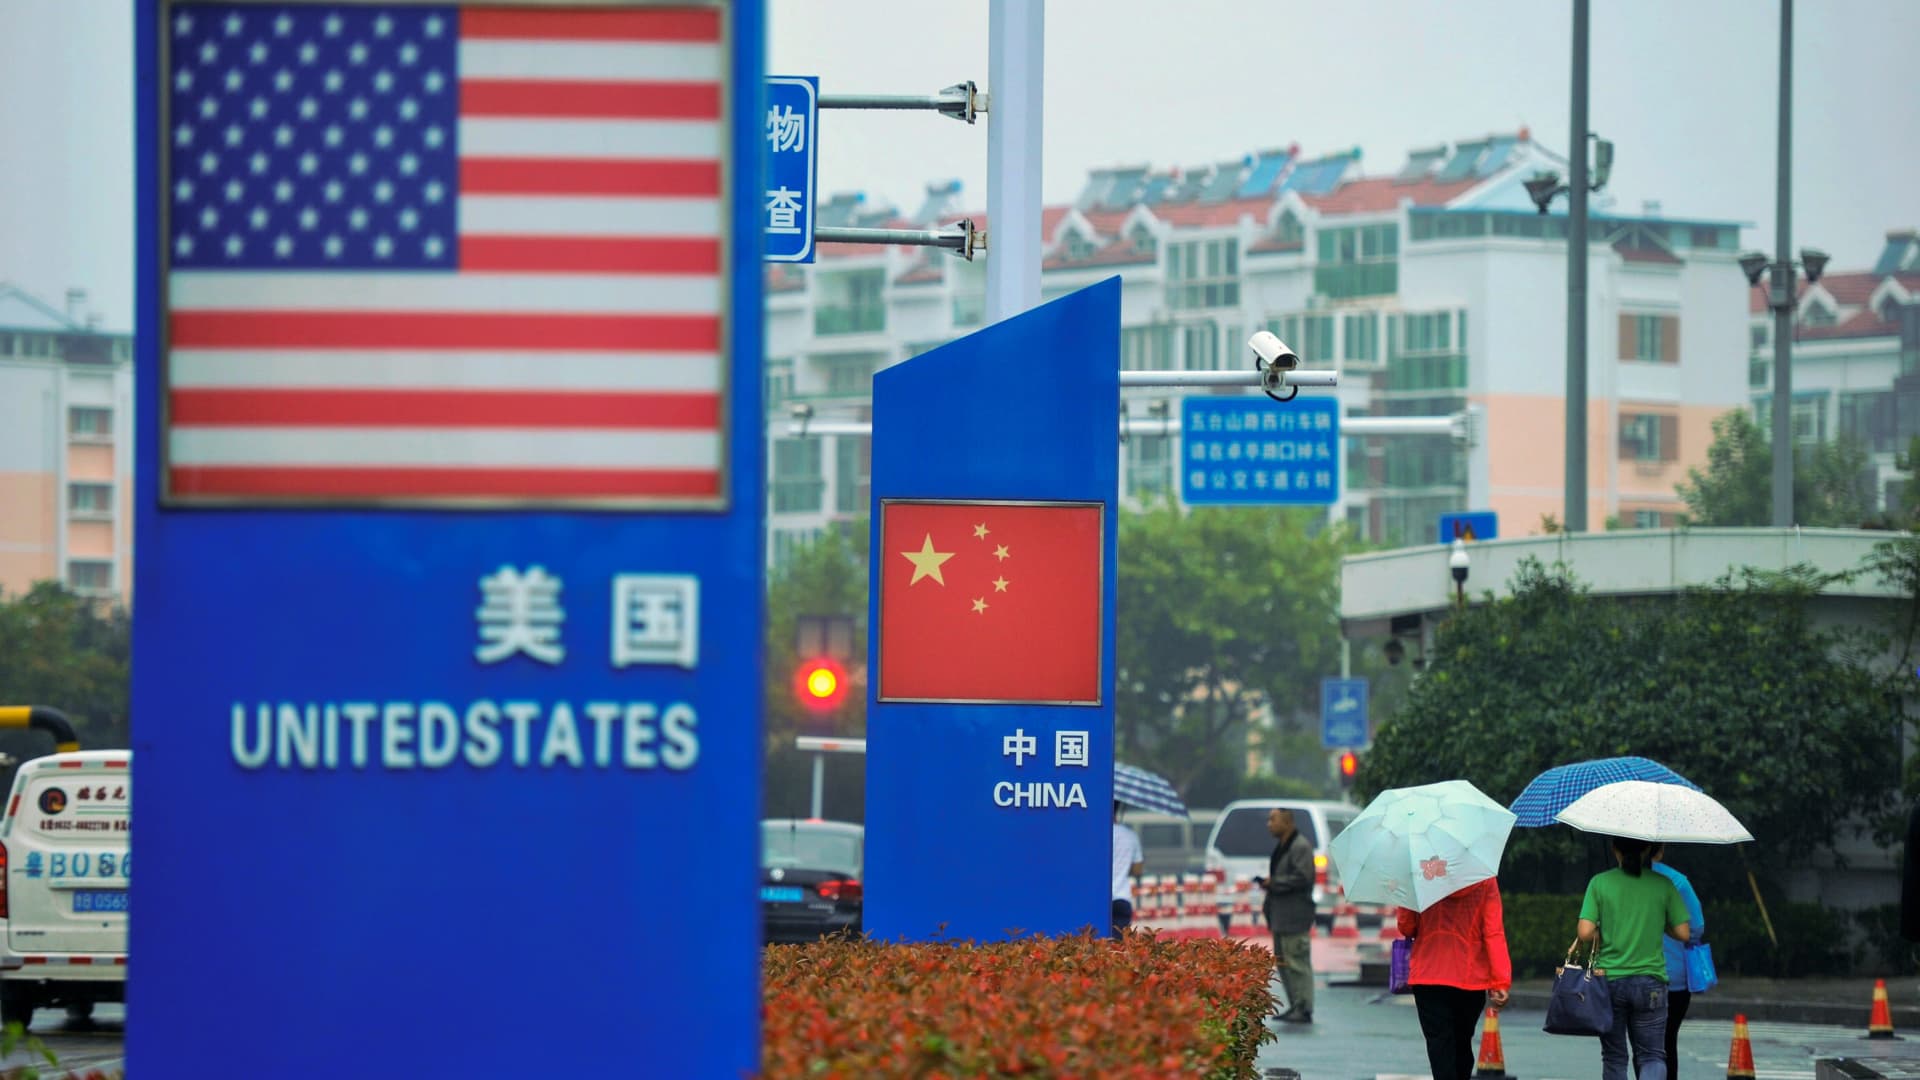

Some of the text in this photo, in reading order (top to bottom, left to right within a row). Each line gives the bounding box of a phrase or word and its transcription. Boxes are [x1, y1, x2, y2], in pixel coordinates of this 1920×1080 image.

[766, 105, 805, 153] 物
[764, 186, 803, 235] 查
[474, 565, 700, 669] 美国
[1002, 728, 1089, 767] 中国
[993, 781, 1089, 808] CHINA
